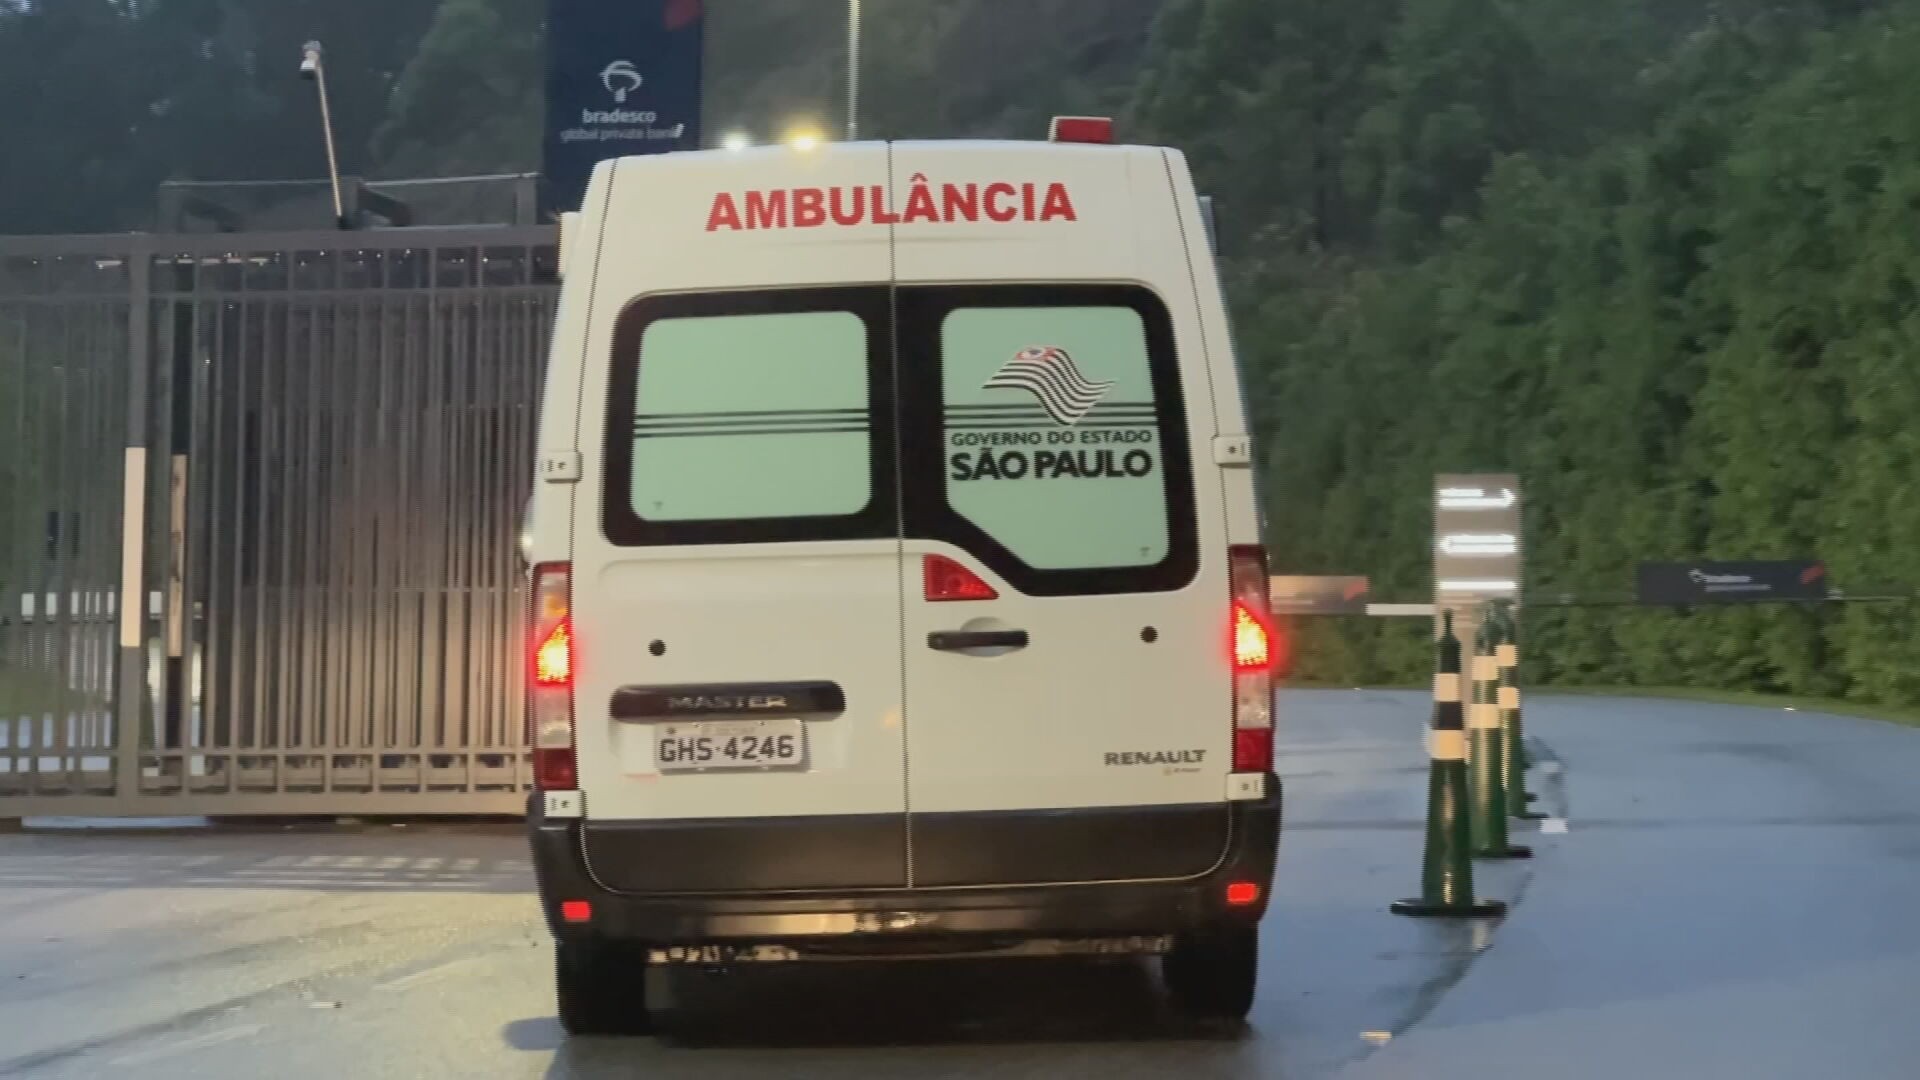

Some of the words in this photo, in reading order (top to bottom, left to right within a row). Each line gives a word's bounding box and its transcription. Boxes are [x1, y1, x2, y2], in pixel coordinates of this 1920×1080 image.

[582, 108, 657, 123] bradesco
[705, 172, 1077, 232] AMBULÂNCIA
[952, 431, 1040, 446] GOVERNO
[1044, 431, 1072, 444] DO
[1077, 429, 1151, 444] ESTADO
[950, 447, 1028, 481] SÃO
[1031, 449, 1152, 479] PAULO
[667, 696, 787, 709] MASTER
[1104, 749, 1207, 766] RENAULT
